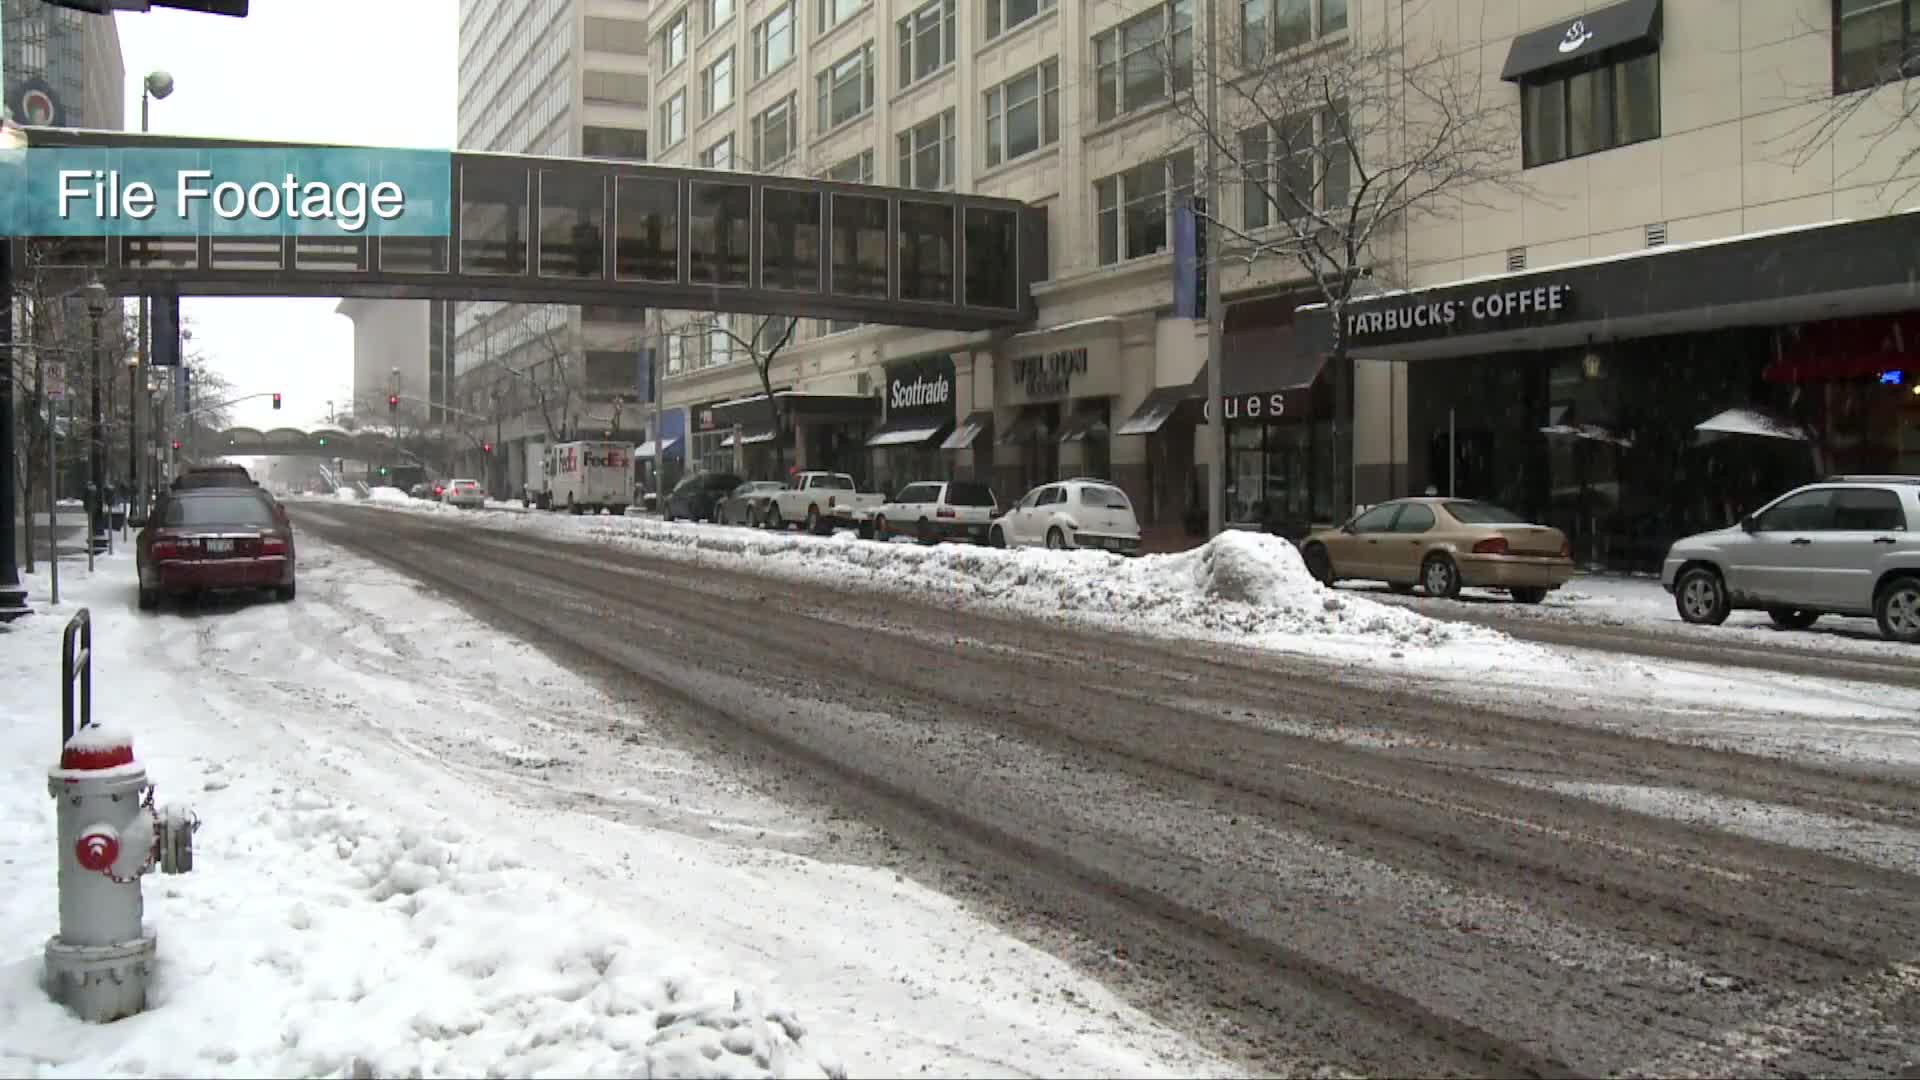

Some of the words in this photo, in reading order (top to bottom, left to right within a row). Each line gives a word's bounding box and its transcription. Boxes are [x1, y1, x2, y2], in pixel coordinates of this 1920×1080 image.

[1346, 302, 1457, 337] TARBUCKS
[1472, 284, 1565, 320] COFFEE
[890, 373, 950, 409] Scottrade
[583, 450, 630, 467] FedEx
